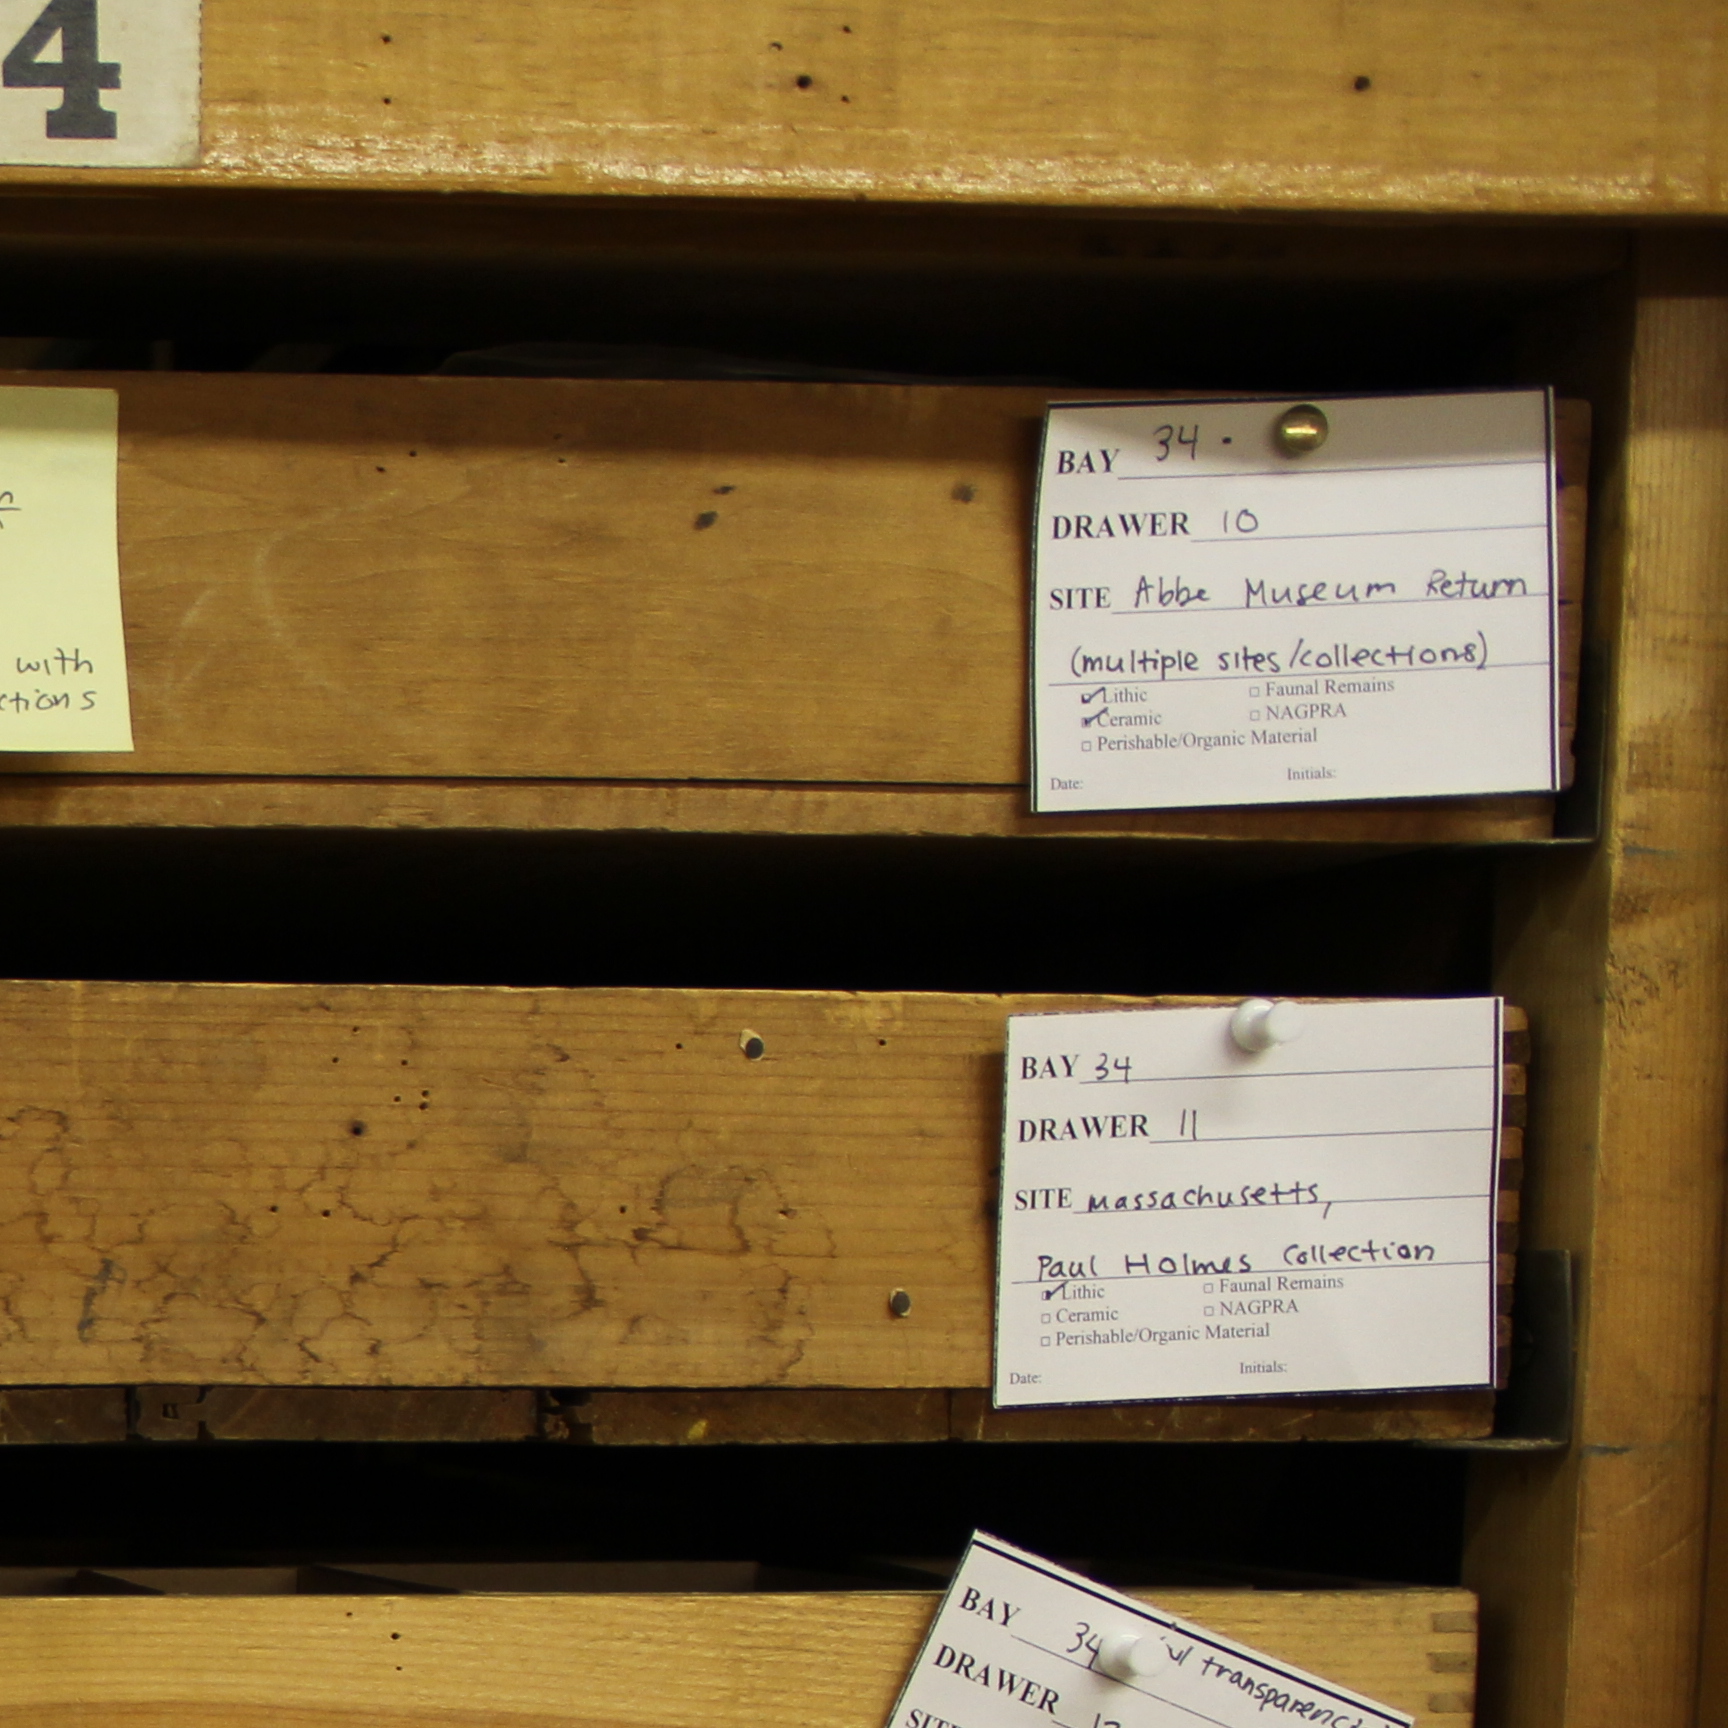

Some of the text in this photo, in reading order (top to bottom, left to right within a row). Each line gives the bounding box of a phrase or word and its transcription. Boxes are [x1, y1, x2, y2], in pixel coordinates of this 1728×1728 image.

[1057, 423, 1200, 475] BAY 34
[1052, 509, 1260, 540] DRAWER 10
[1049, 568, 1529, 611] SITE Abbe Museum Return
[16, 647, 95, 675] with
[1070, 646, 1200, 681] (multiple
[1097, 728, 1318, 753] Perishable/Organic Material
[1020, 1052, 1133, 1083] BAY 34
[1018, 1114, 1151, 1142] DRAWER
[1014, 1188, 1073, 1211] SITE
[1037, 1254, 1096, 1282] Paul
[1125, 1253, 1253, 1277] Holmes
[1220, 1275, 1344, 1294] Faunal Remains
[958, 1586, 1022, 1629] BAY
[932, 1644, 1061, 1716] DRAWER
